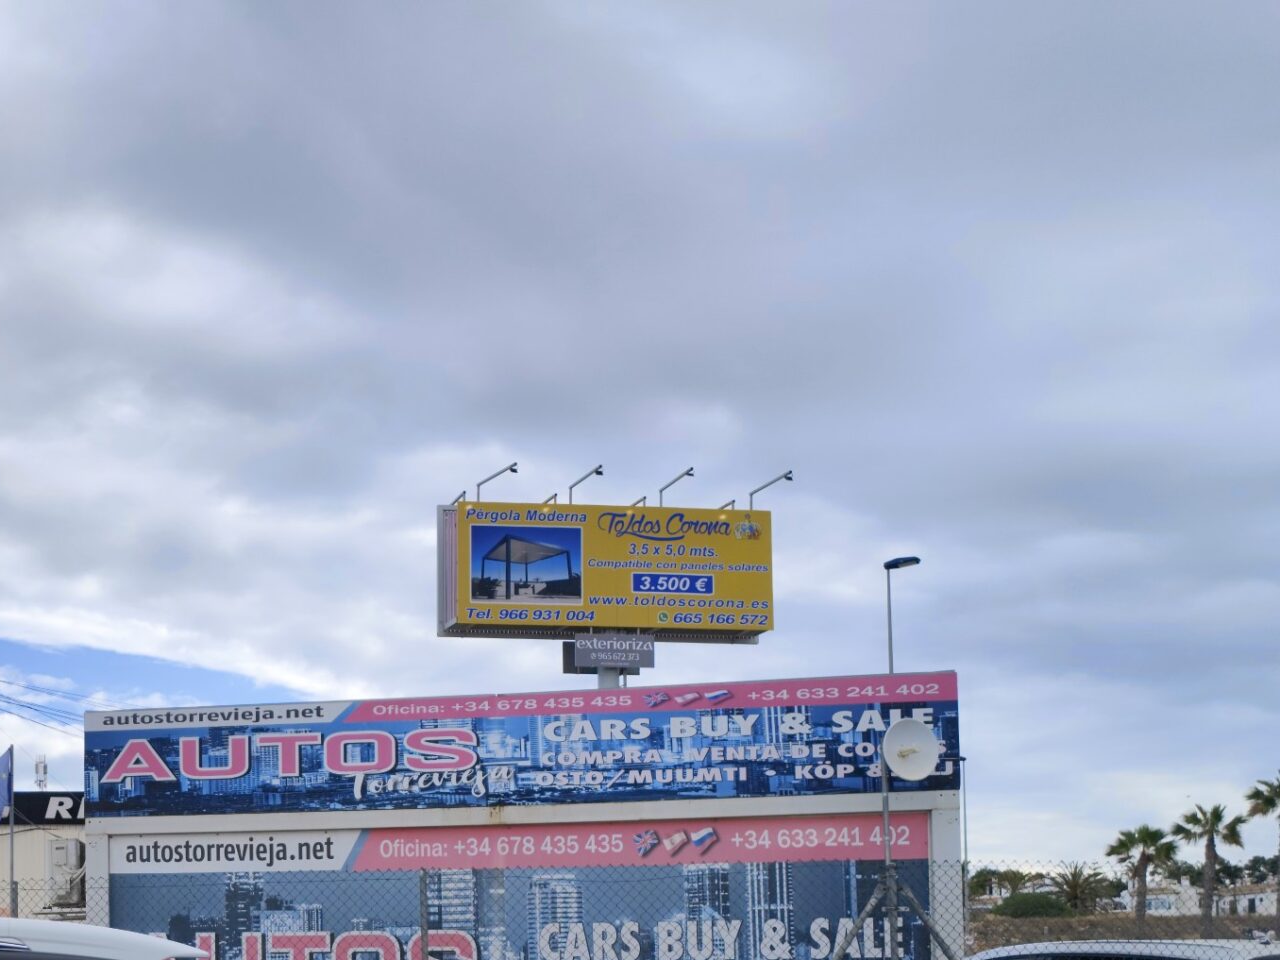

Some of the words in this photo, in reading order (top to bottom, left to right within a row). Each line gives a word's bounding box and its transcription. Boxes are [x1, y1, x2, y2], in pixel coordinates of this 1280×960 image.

[466, 508, 521, 523] Pérgola
[526, 510, 587, 522] Moderna
[597, 512, 661, 541] Toldos
[665, 512, 732, 536] Corona
[628, 543, 649, 556] 3,5
[652, 547, 661, 556] x
[665, 544, 686, 557] 5,0
[689, 546, 719, 557] mts.
[587, 558, 653, 569] Compatible
[656, 561, 677, 569] con
[680, 561, 724, 571] paneles
[727, 563, 769, 572] solares
[639, 575, 691, 591] 3.500
[695, 578, 708, 592] €
[588, 595, 770, 609] www.toldoscorona.es
[466, 607, 493, 620] Tel.
[498, 608, 529, 620] 966
[532, 609, 561, 621] 931
[565, 610, 596, 622] 004
[673, 612, 703, 625] 665
[707, 612, 736, 625] 166
[739, 613, 769, 626] 572
[576, 637, 654, 650] exterioriza
[747, 688, 792, 702] +34
[796, 686, 842, 700] 633
[846, 685, 891, 699] 241
[896, 683, 940, 697] 402
[102, 704, 325, 726] autostorrevieja.net
[372, 700, 446, 716] Oficina:
[451, 699, 492, 714] +34
[496, 697, 538, 711] 678
[543, 696, 585, 710] 435
[589, 695, 632, 709] 435
[543, 716, 652, 743] CARS
[669, 713, 760, 738] BUY
[780, 712, 813, 735] &
[100, 728, 480, 784] AUTOS
[541, 749, 664, 767] COMPRA
[687, 745, 782, 763] VENTA
[791, 743, 827, 759] DE
[795, 760, 854, 780] KÖP
[344, 764, 515, 800] Torrevieja
[731, 829, 772, 849] +34
[777, 828, 819, 849] 633
[824, 826, 865, 847] 241
[125, 837, 335, 867] autostorrevieja.net
[379, 839, 449, 858] Oficina:
[453, 838, 492, 856] +34
[496, 836, 536, 856] 678
[540, 834, 580, 854] 435
[585, 833, 624, 853] 435
[760, 918, 793, 960] &
[809, 917, 905, 959] SALE
